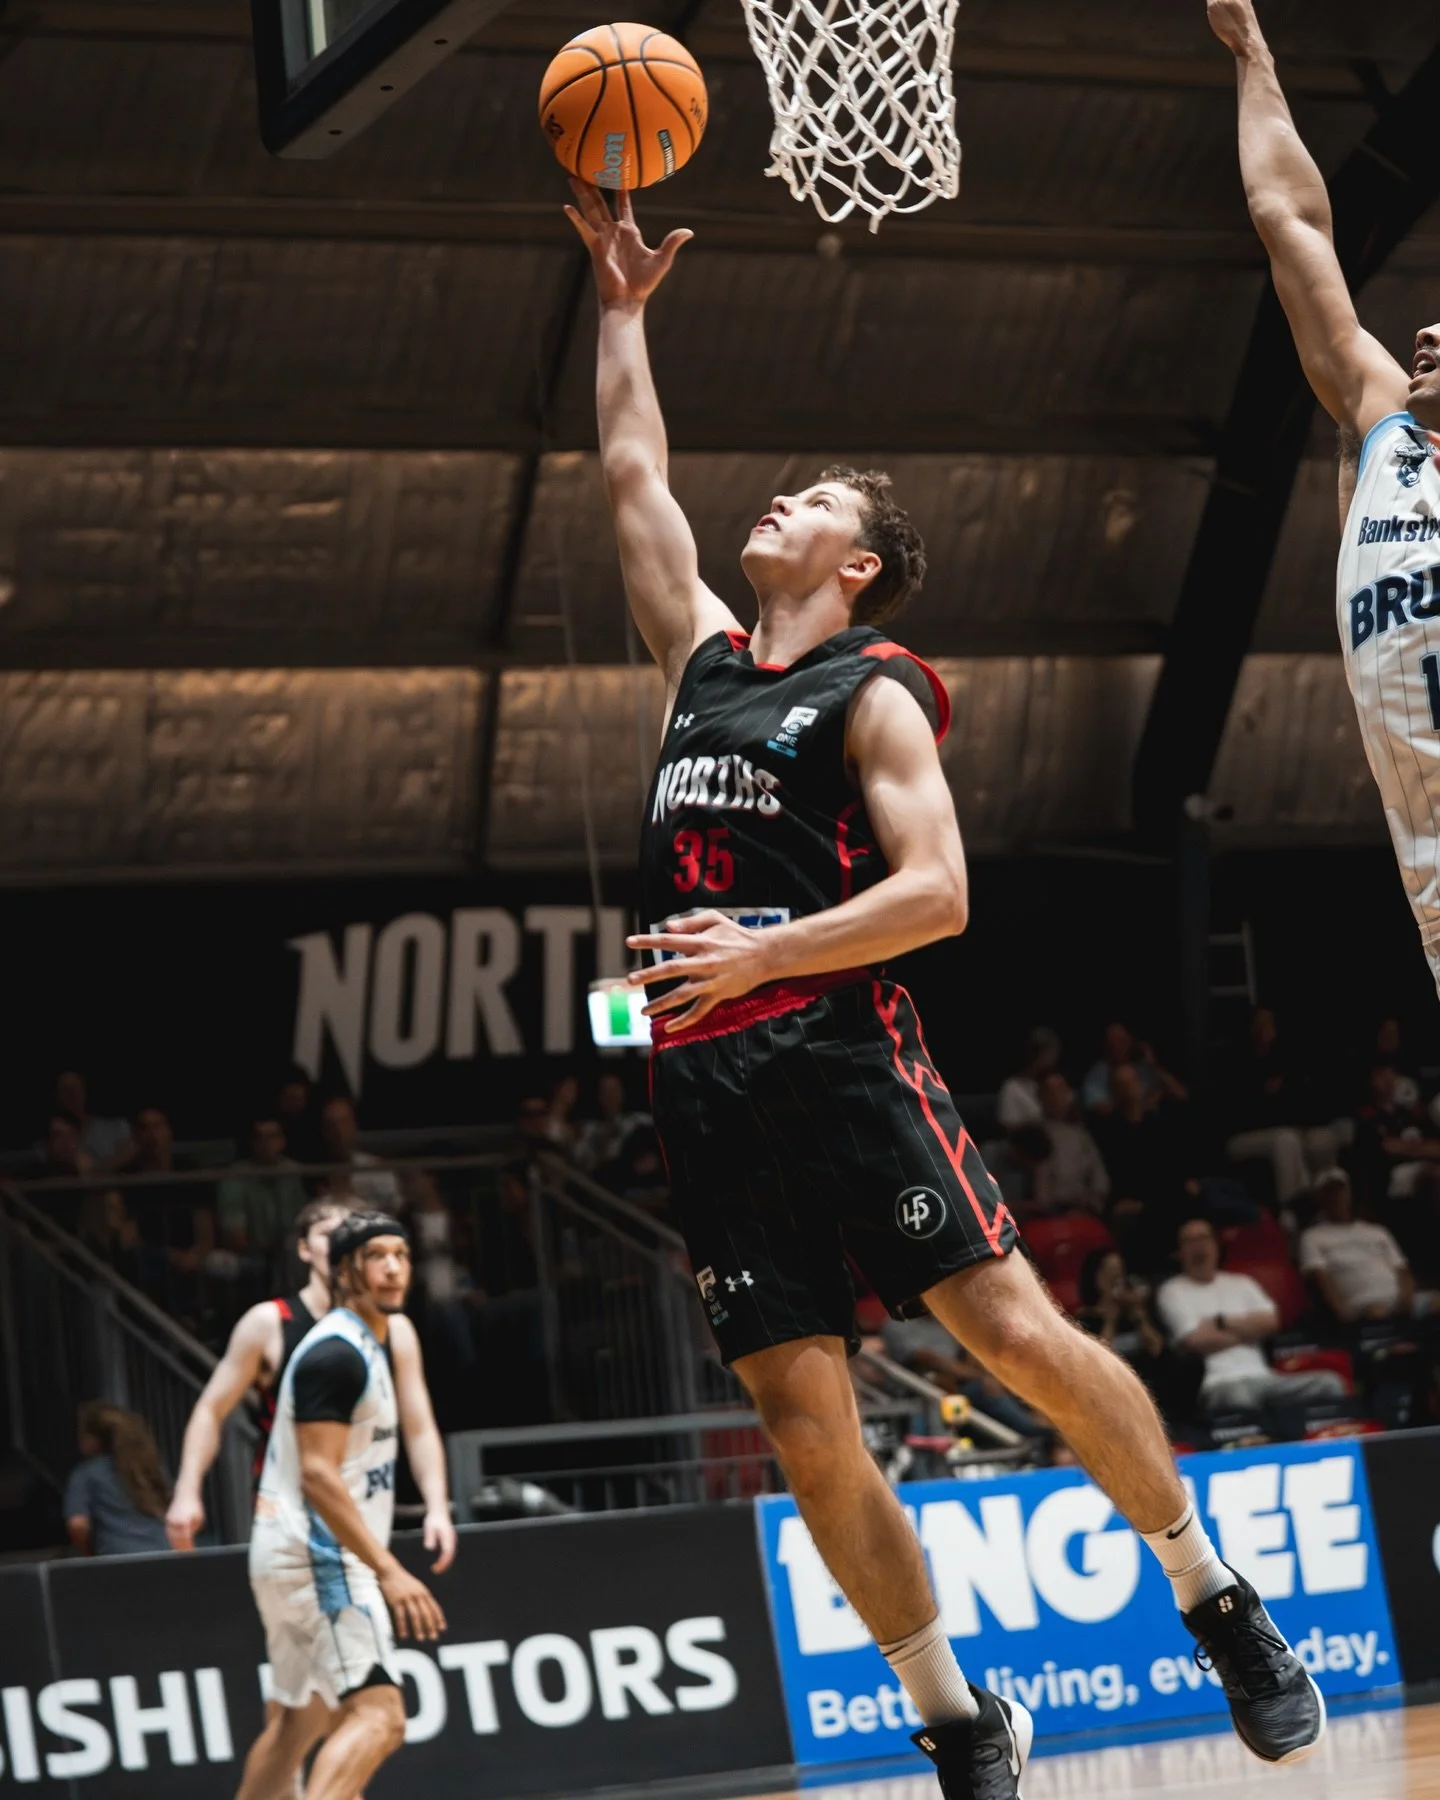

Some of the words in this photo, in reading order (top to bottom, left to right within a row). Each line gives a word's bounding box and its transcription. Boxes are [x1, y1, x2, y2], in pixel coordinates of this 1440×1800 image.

[652, 754, 783, 826] NORTHS
[673, 827, 736, 893] 35
[777, 1486, 1140, 1656] BNG
[1181, 1455, 1368, 1602] EE
[0, 1667, 234, 1783] ISHI
[258, 1616, 739, 1743] OTORS
[807, 1684, 928, 1738] Bett
[984, 1660, 1140, 1711] living,
